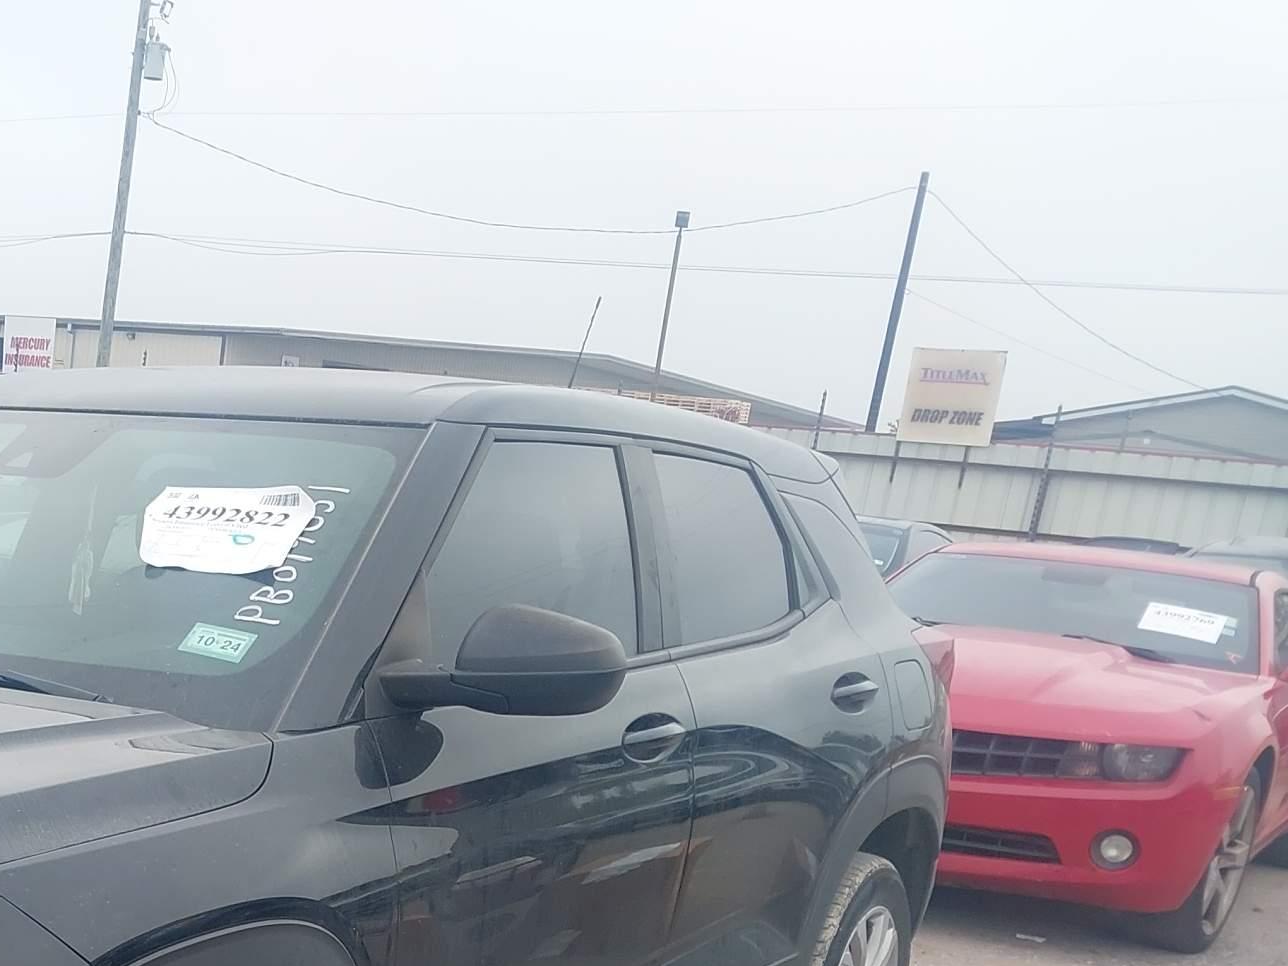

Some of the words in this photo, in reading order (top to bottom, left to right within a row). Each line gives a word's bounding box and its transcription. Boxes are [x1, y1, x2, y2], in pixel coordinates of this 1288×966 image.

[10, 336, 51, 351] MERCURY
[4, 353, 52, 368] INSURANCE
[911, 408, 949, 424] DROP
[949, 411, 985, 426] ZONE
[162, 504, 291, 528] 43992822
